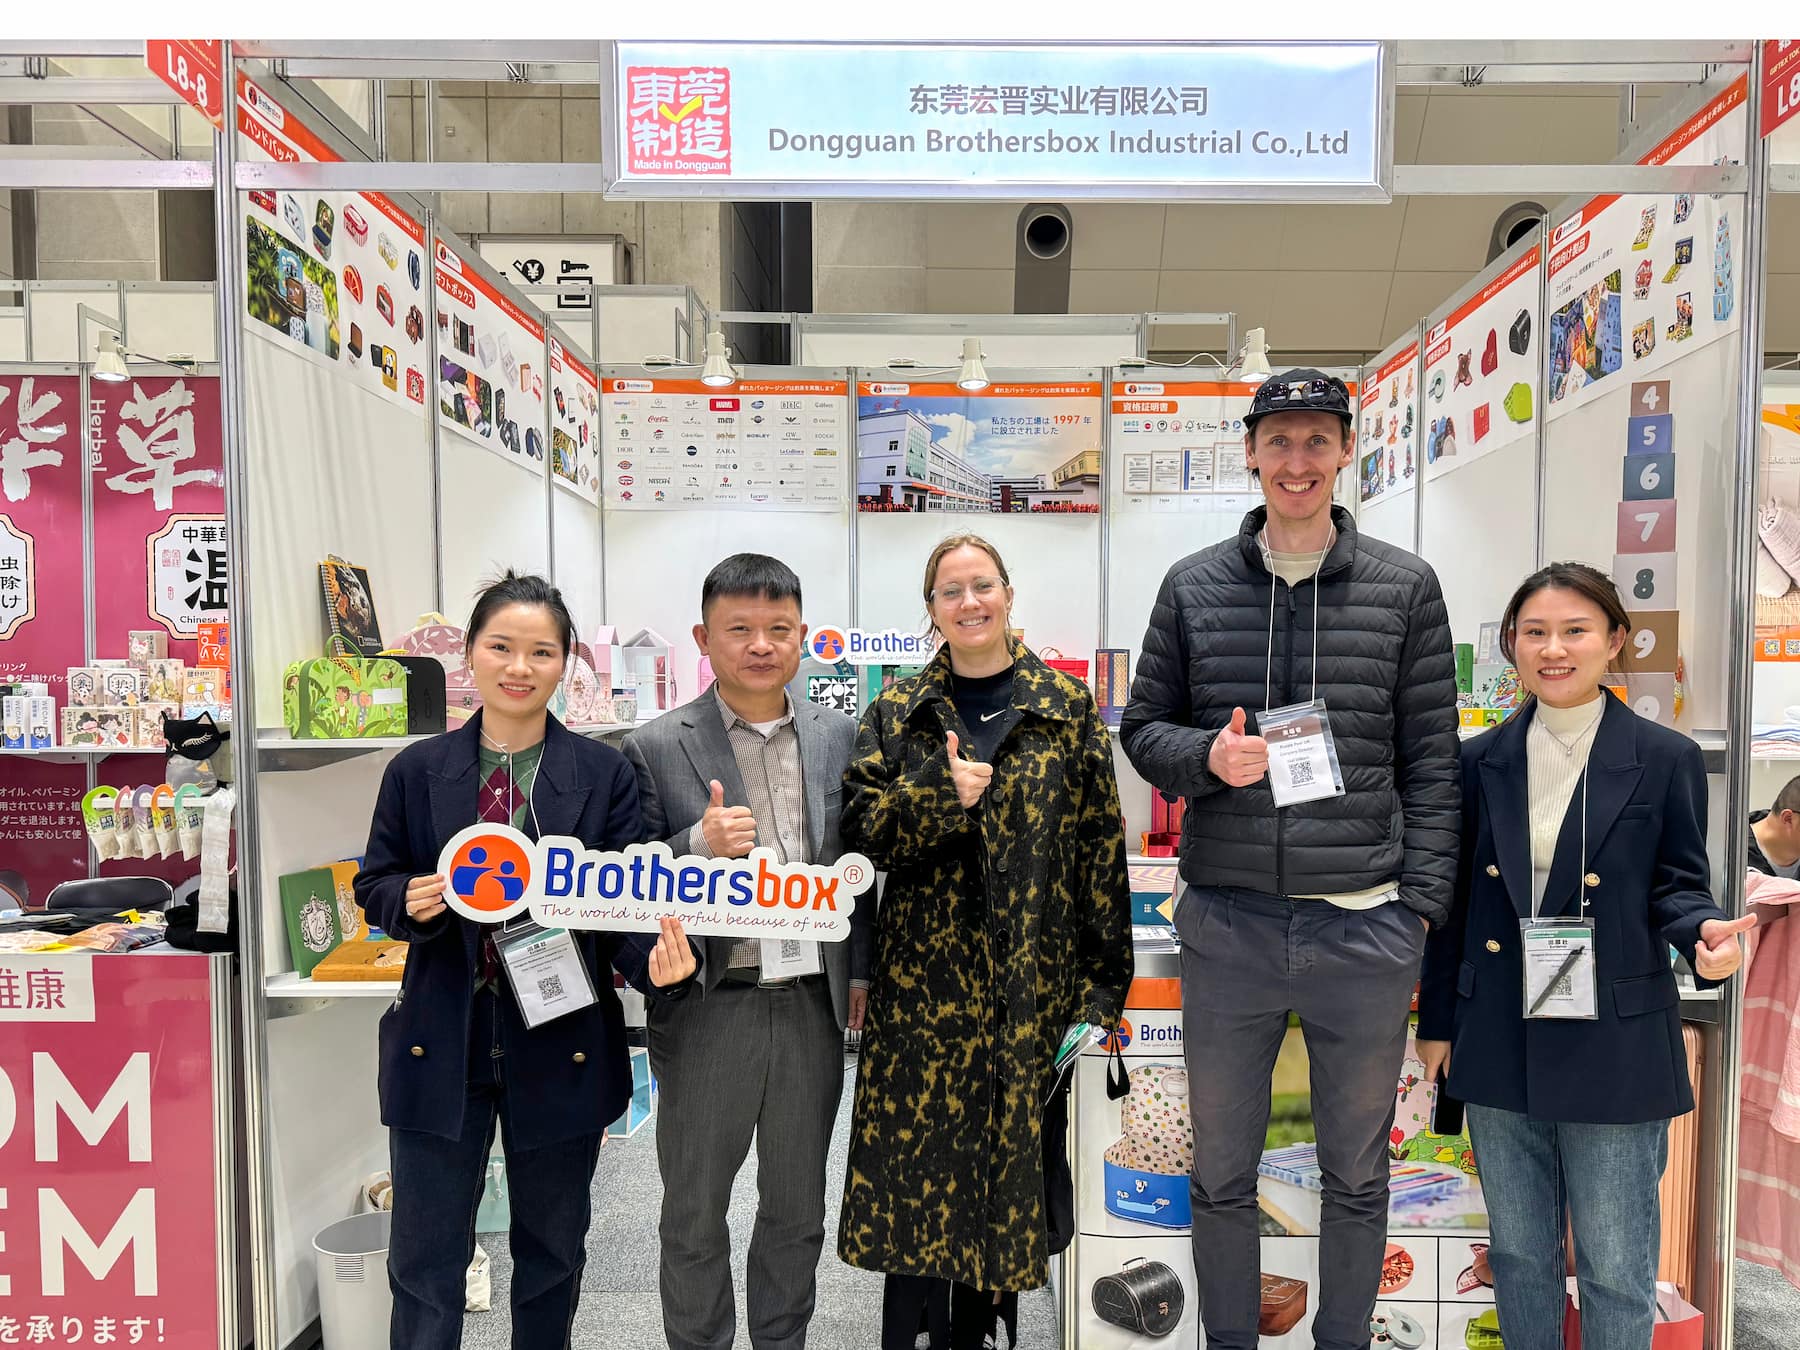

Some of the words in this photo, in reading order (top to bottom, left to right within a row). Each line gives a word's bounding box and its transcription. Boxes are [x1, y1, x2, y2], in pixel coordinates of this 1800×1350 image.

[166, 43, 208, 108] L8-8
[908, 84, 1209, 117] 东莞宏晋实业有限公司
[768, 127, 916, 159] Dongguan
[925, 127, 1100, 154] Brothersbox
[1109, 128, 1242, 155] Industrial
[1251, 129, 1350, 158] Co.,Ltd
[633, 159, 662, 170] Made
[662, 159, 673, 170] in
[674, 159, 727, 172] Dongguan
[1122, 402, 1169, 413] 資格証明書
[1641, 384, 1660, 410] 4
[991, 416, 1050, 425] 私たちの工場は
[1053, 415, 1081, 425] 1997
[1083, 415, 1093, 424] 年
[991, 426, 1059, 435] に設立されました
[90, 399, 108, 472] Herbal
[1643, 425, 1657, 446] 5
[715, 447, 736, 455] ZARA
[1639, 462, 1661, 491] 6
[1635, 511, 1661, 542] 7
[1632, 568, 1655, 600] 8
[179, 615, 218, 624] Chinese
[1634, 629, 1657, 660] 9
[0, 662, 28, 672] リング
[544, 847, 840, 912] Brothersbox
[540, 903, 575, 917] The
[579, 907, 631, 920] world
[634, 907, 651, 921] is
[725, 912, 789, 929] because
[792, 916, 811, 933] of
[813, 920, 840, 931] me
[0, 1051, 153, 1163] M
[0, 1187, 159, 1297] M
